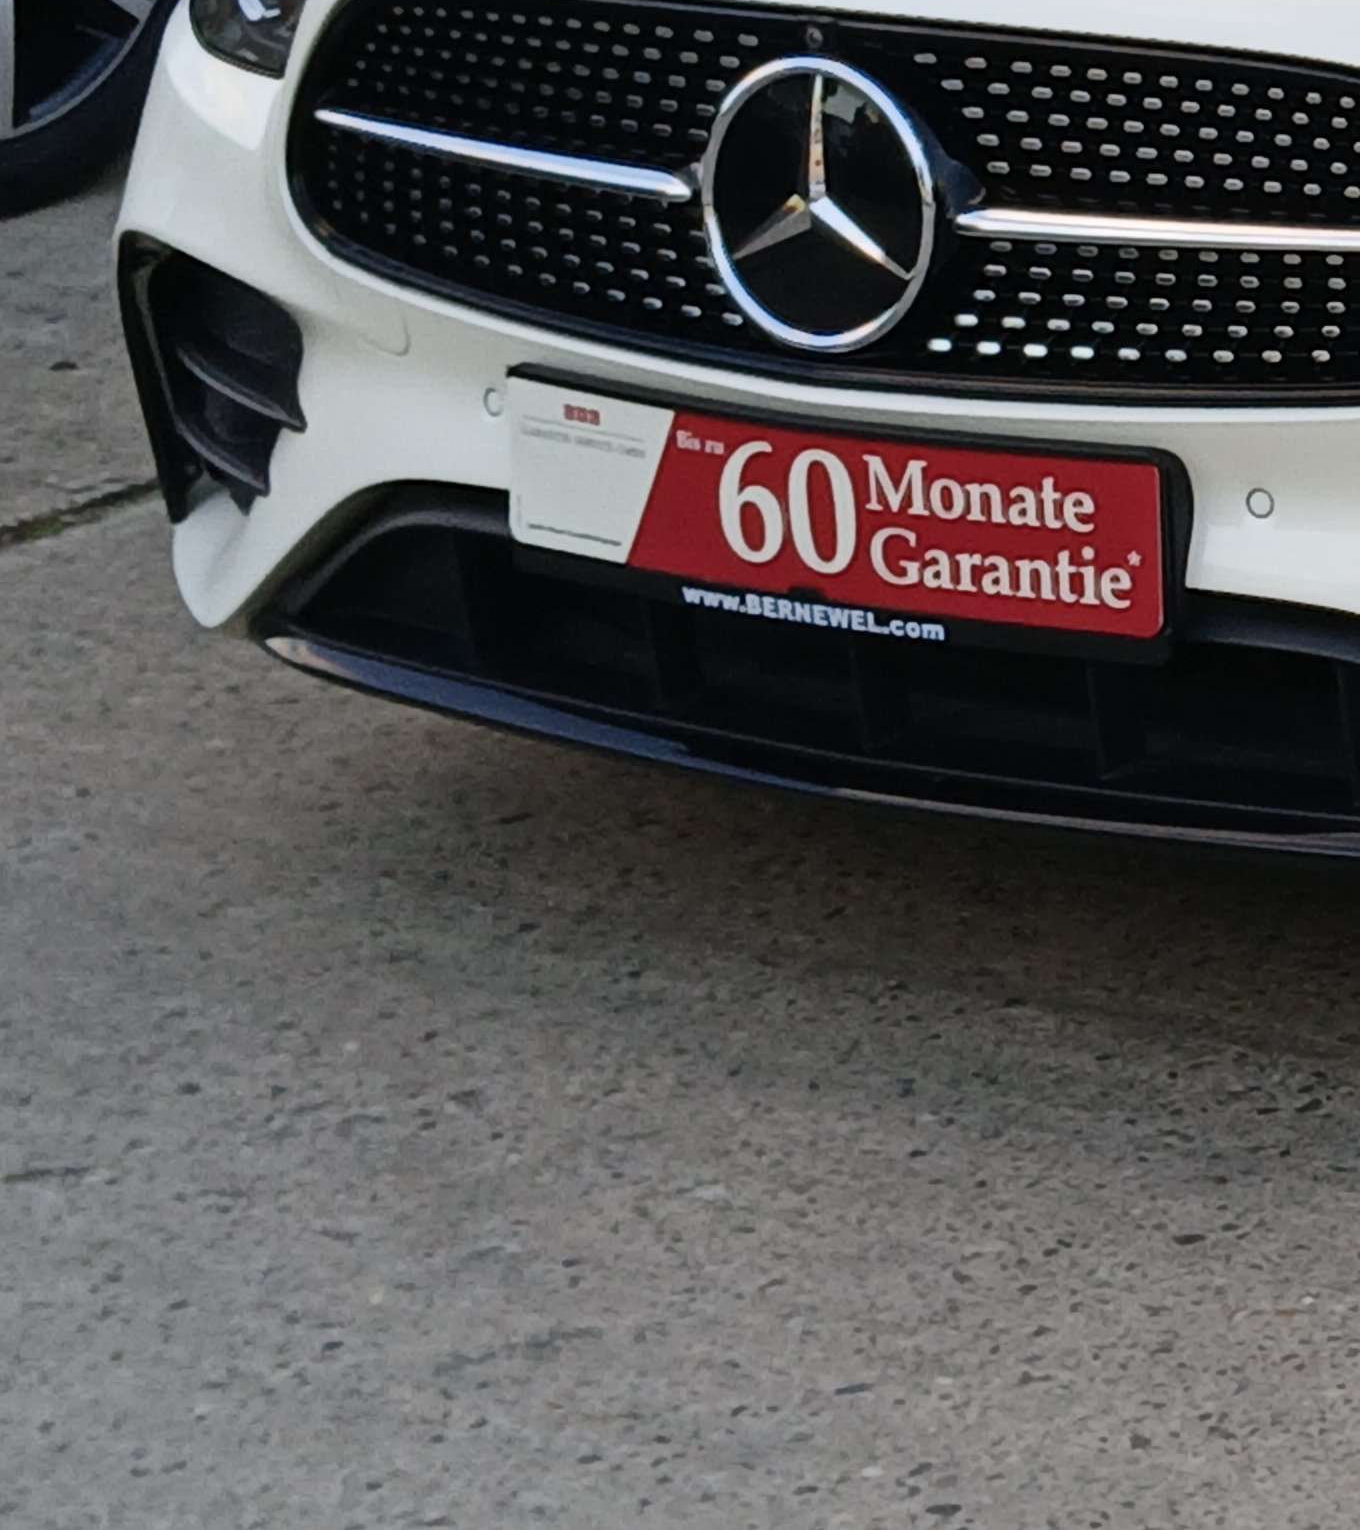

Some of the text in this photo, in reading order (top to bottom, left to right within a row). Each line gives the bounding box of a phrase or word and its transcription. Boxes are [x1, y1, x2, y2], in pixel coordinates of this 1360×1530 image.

[718, 441, 1095, 575] 60 Monate
[682, 586, 945, 641] www.BERNEWEL.com
